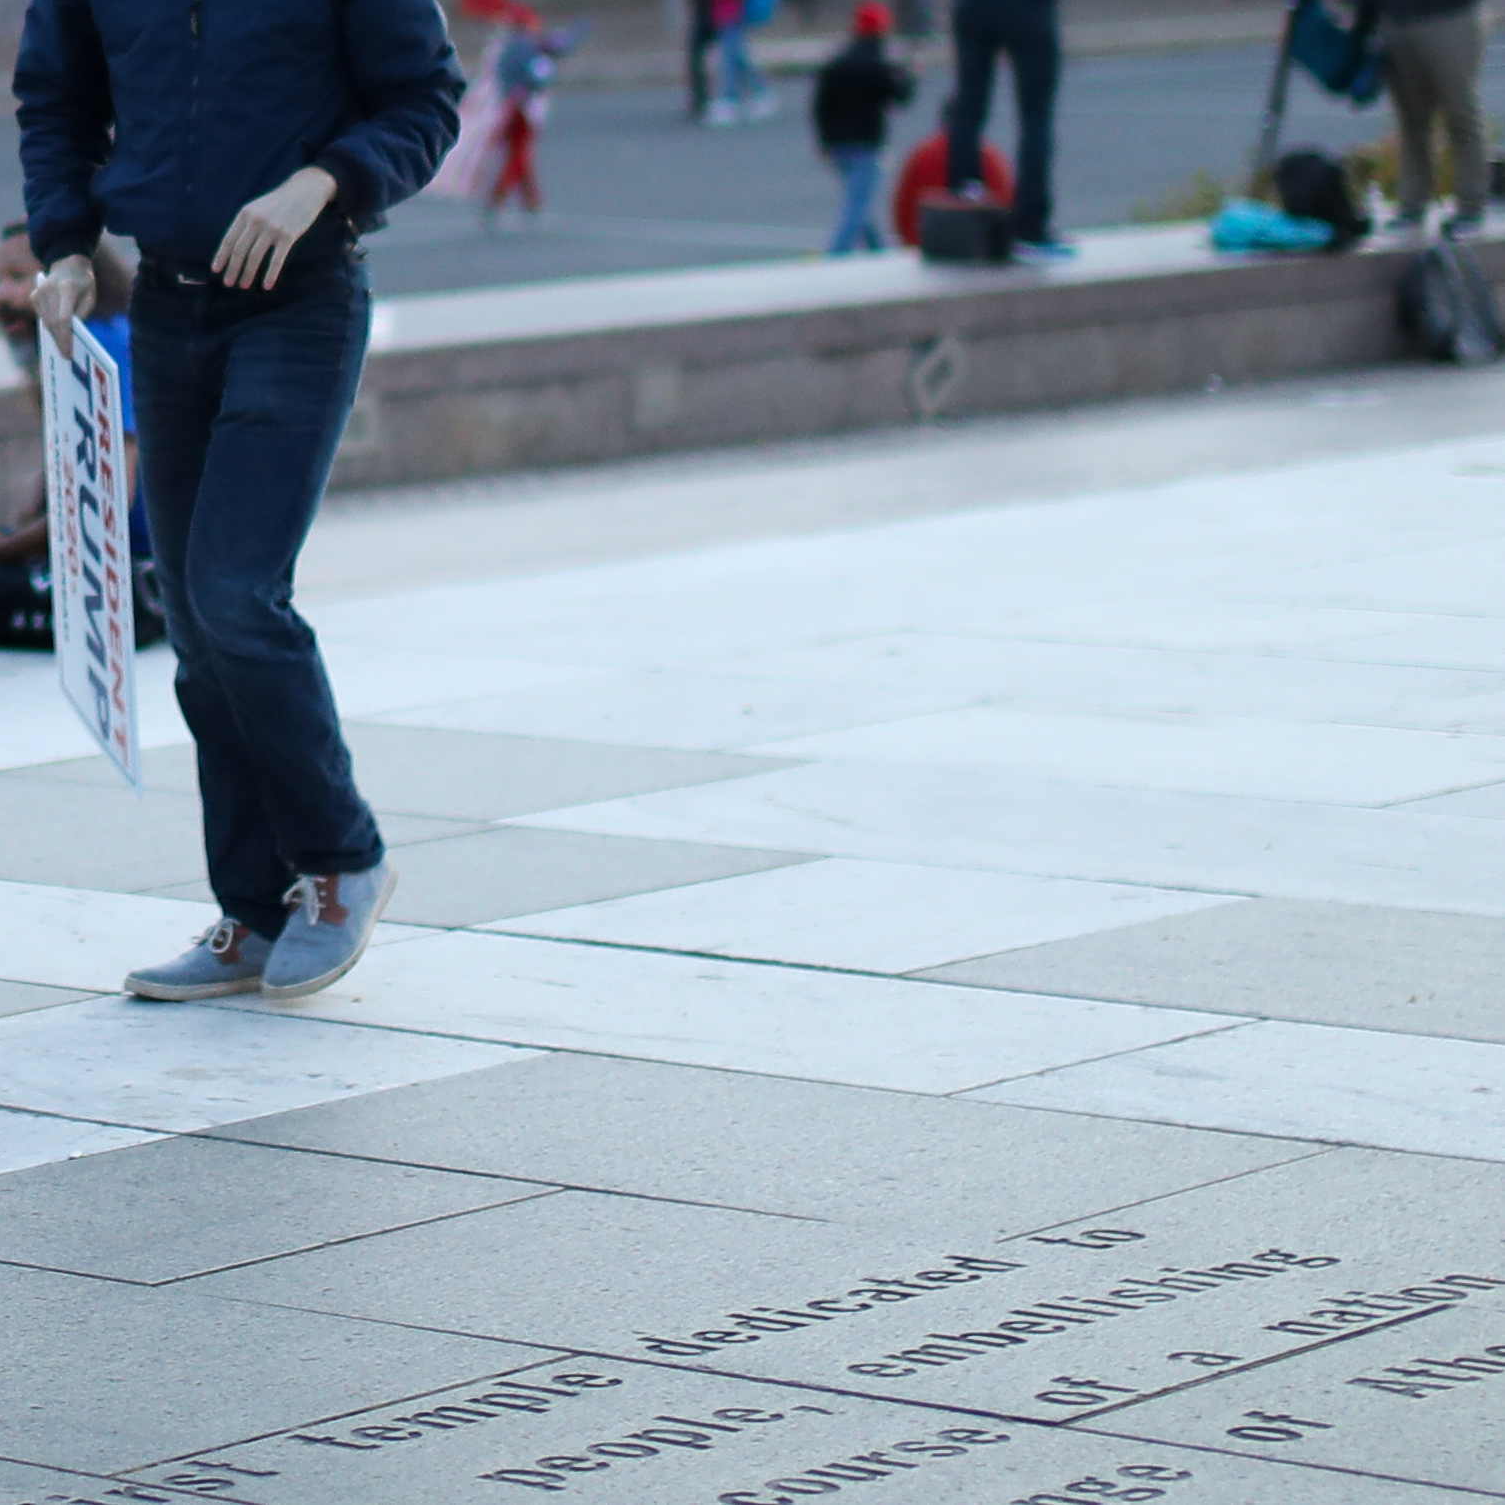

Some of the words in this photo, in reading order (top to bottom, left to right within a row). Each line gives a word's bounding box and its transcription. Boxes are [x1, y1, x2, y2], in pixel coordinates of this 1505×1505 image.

[63, 458, 78, 577] 2020
[71, 352, 111, 741] TRUMP
[95, 361, 130, 767] PRESIDENT
[288, 1371, 625, 1451] temple
[636, 1253, 1029, 1357] dedicated
[1027, 1227, 1147, 1250] to
[475, 1404, 835, 1491] people,
[847, 1247, 1342, 1379] embellishing
[717, 1427, 1012, 1505] course
[1033, 1375, 1140, 1407] of
[1167, 1349, 1245, 1367] a
[1260, 1273, 1505, 1337] nation
[1225, 1409, 1337, 1443] of
